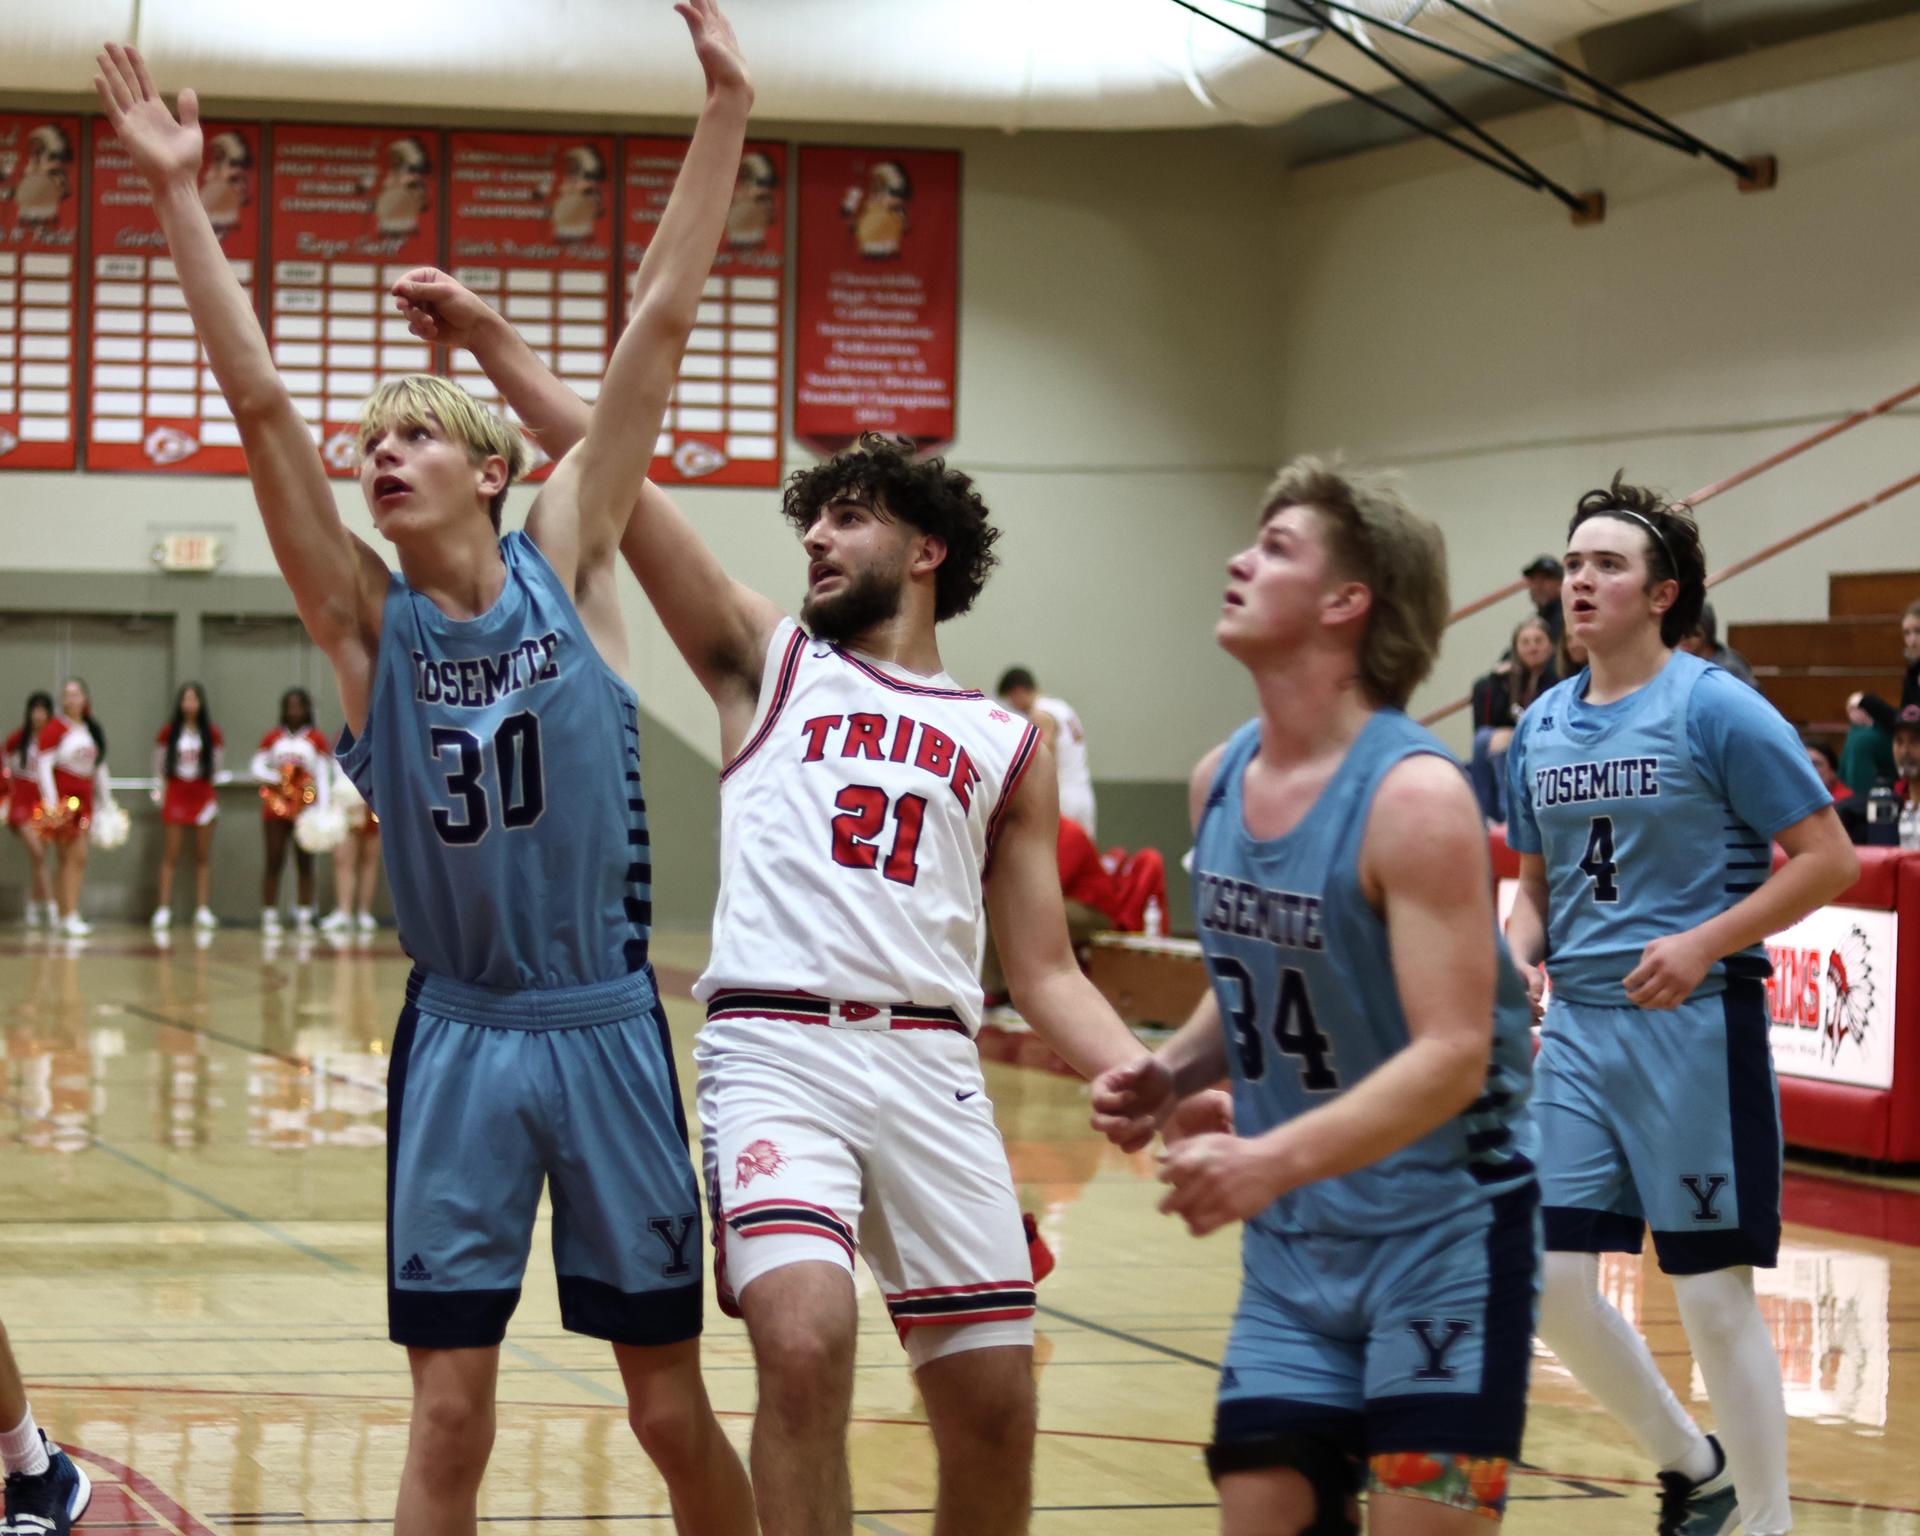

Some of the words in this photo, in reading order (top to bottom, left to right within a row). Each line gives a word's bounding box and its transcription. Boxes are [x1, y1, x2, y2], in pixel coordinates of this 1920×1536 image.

[430, 709, 546, 847] 30
[801, 711, 982, 818] TRIBE
[1535, 757, 1660, 810] YOSEMITE
[831, 783, 929, 888] 21
[1579, 815, 1620, 904] 4
[1207, 952, 1339, 1092] 34
[1680, 1173, 1729, 1223] Y
[647, 1211, 697, 1279] Y
[1407, 1318, 1474, 1381] Y
